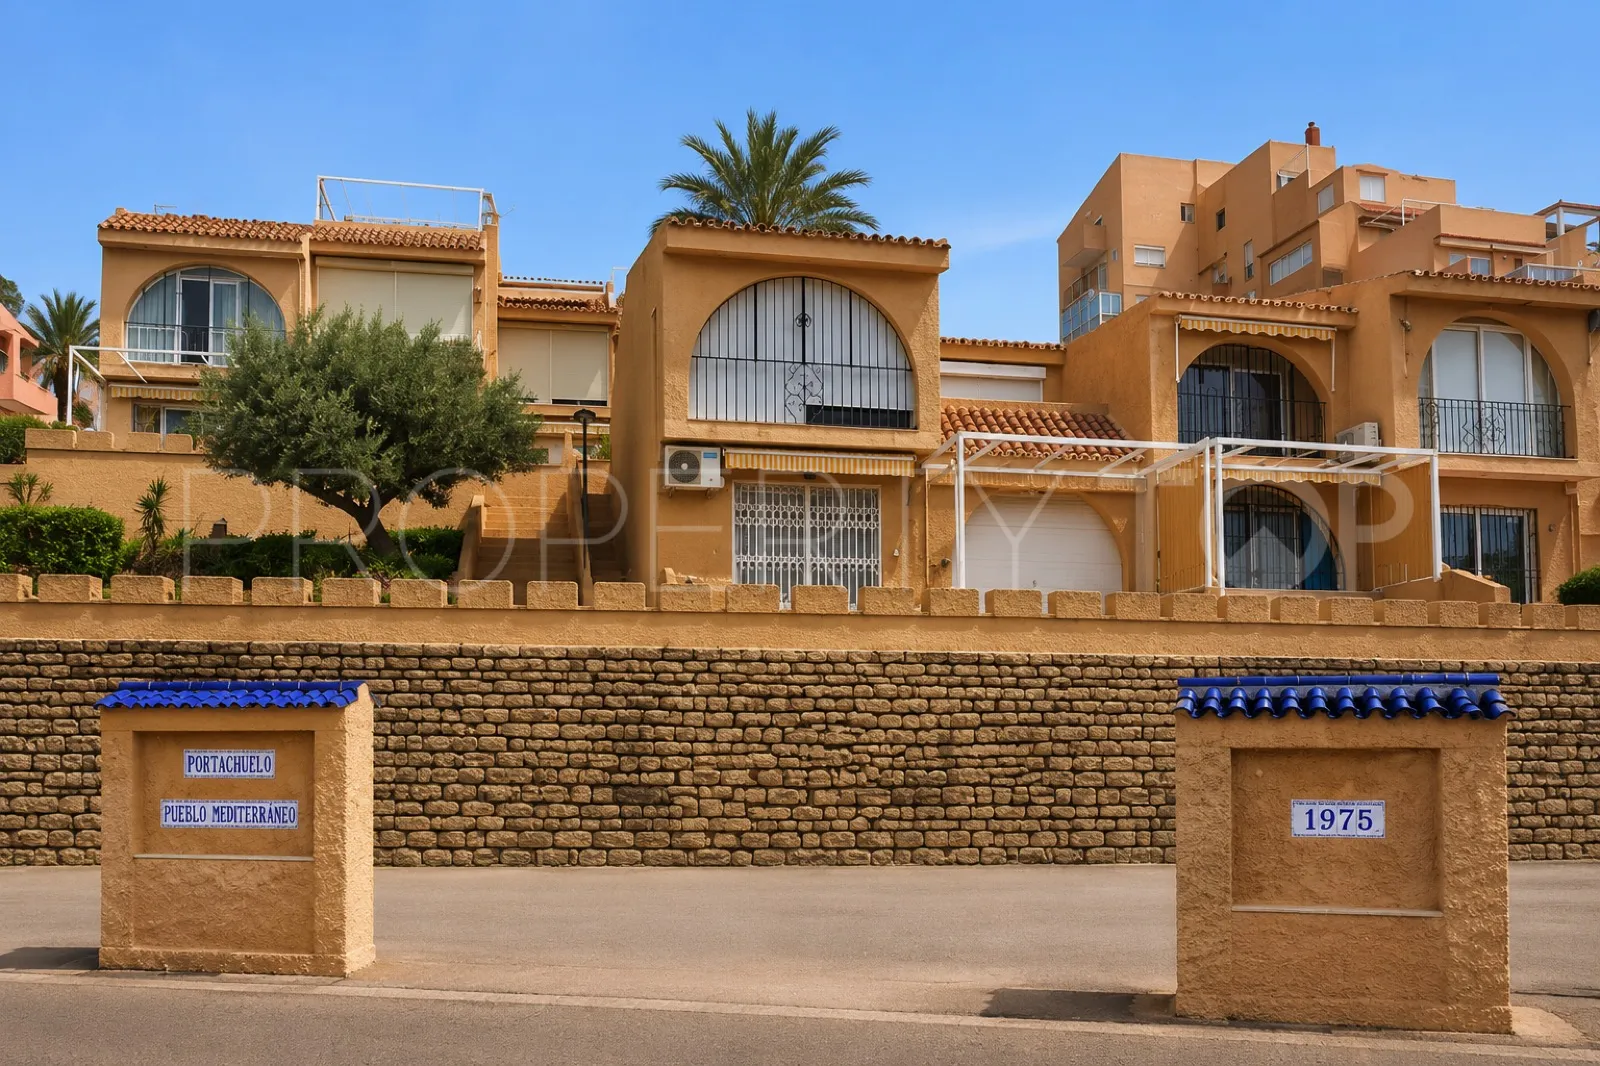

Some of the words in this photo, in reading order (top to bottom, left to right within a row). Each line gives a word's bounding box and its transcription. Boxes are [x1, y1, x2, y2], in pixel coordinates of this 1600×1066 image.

[187, 755, 272, 773] PORTACHUELO
[164, 805, 207, 823] PUEBLO
[211, 802, 296, 824] MEDITERRÁNEO
[1305, 808, 1373, 831] 1975
